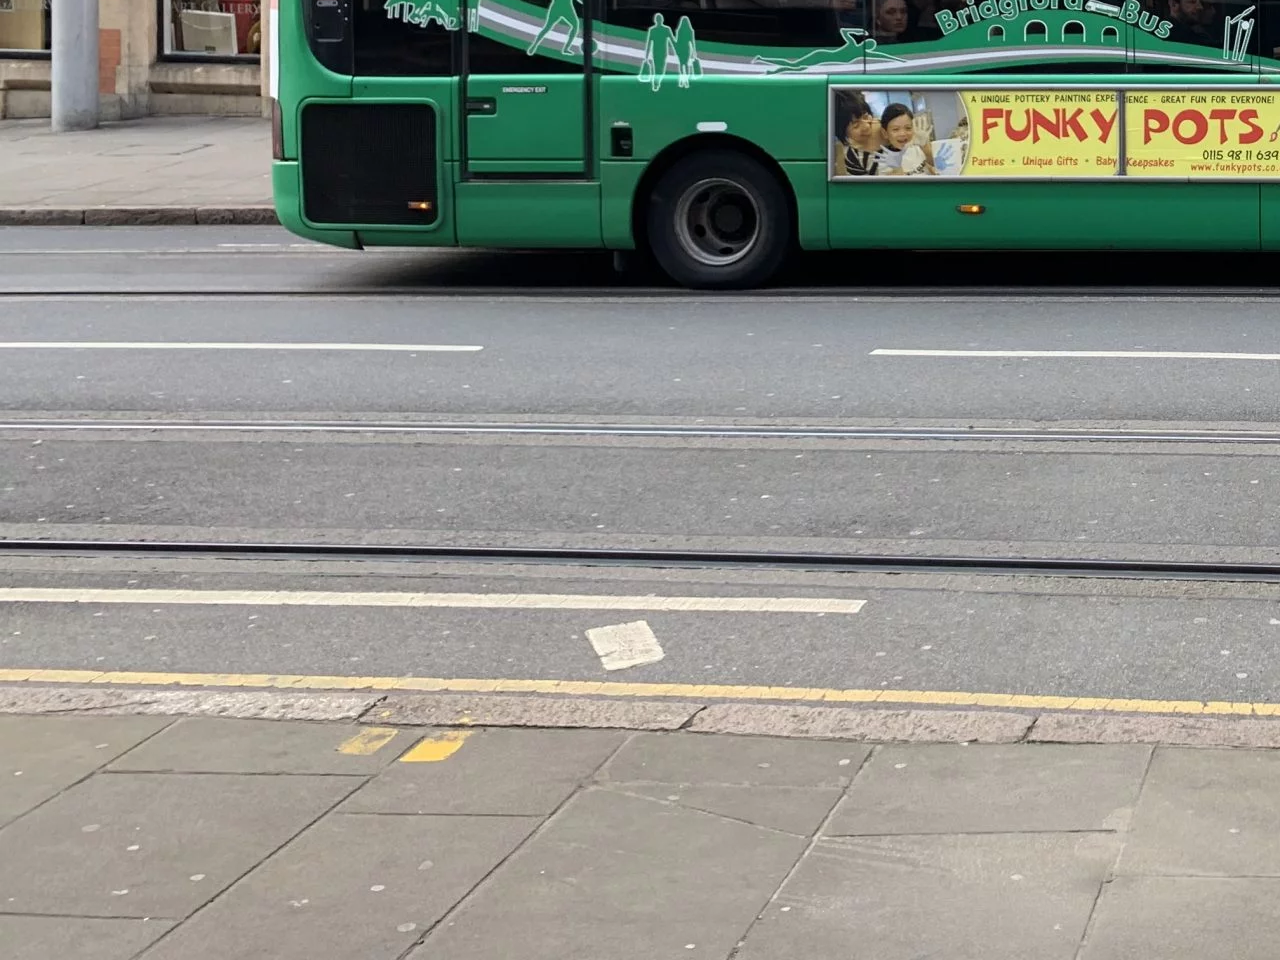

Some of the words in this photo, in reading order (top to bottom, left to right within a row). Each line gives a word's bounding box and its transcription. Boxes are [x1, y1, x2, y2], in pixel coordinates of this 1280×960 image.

[971, 95, 977, 103] A
[980, 94, 1011, 103] UNIQUE
[1014, 94, 1050, 103] POTTERY
[1054, 94, 1092, 103] PAINTING
[1160, 95, 1186, 104] GREAT
[1190, 95, 1207, 104] FUN
[1210, 95, 1227, 104] FOR
[1230, 95, 1275, 104] EVERYONE!
[981, 108, 1118, 145] FUNKY
[1143, 108, 1264, 146] POTS
[1202, 149, 1224, 161] 0115
[1227, 149, 1242, 161] 98
[1244, 149, 1253, 161] 11
[1256, 149, 1280, 161] 639
[971, 156, 1006, 167] Parties
[1021, 156, 1054, 169] Unique
[1056, 156, 1078, 167] Gifts
[1096, 156, 1118, 169] Baby
[1126, 157, 1175, 170] Keepsakes
